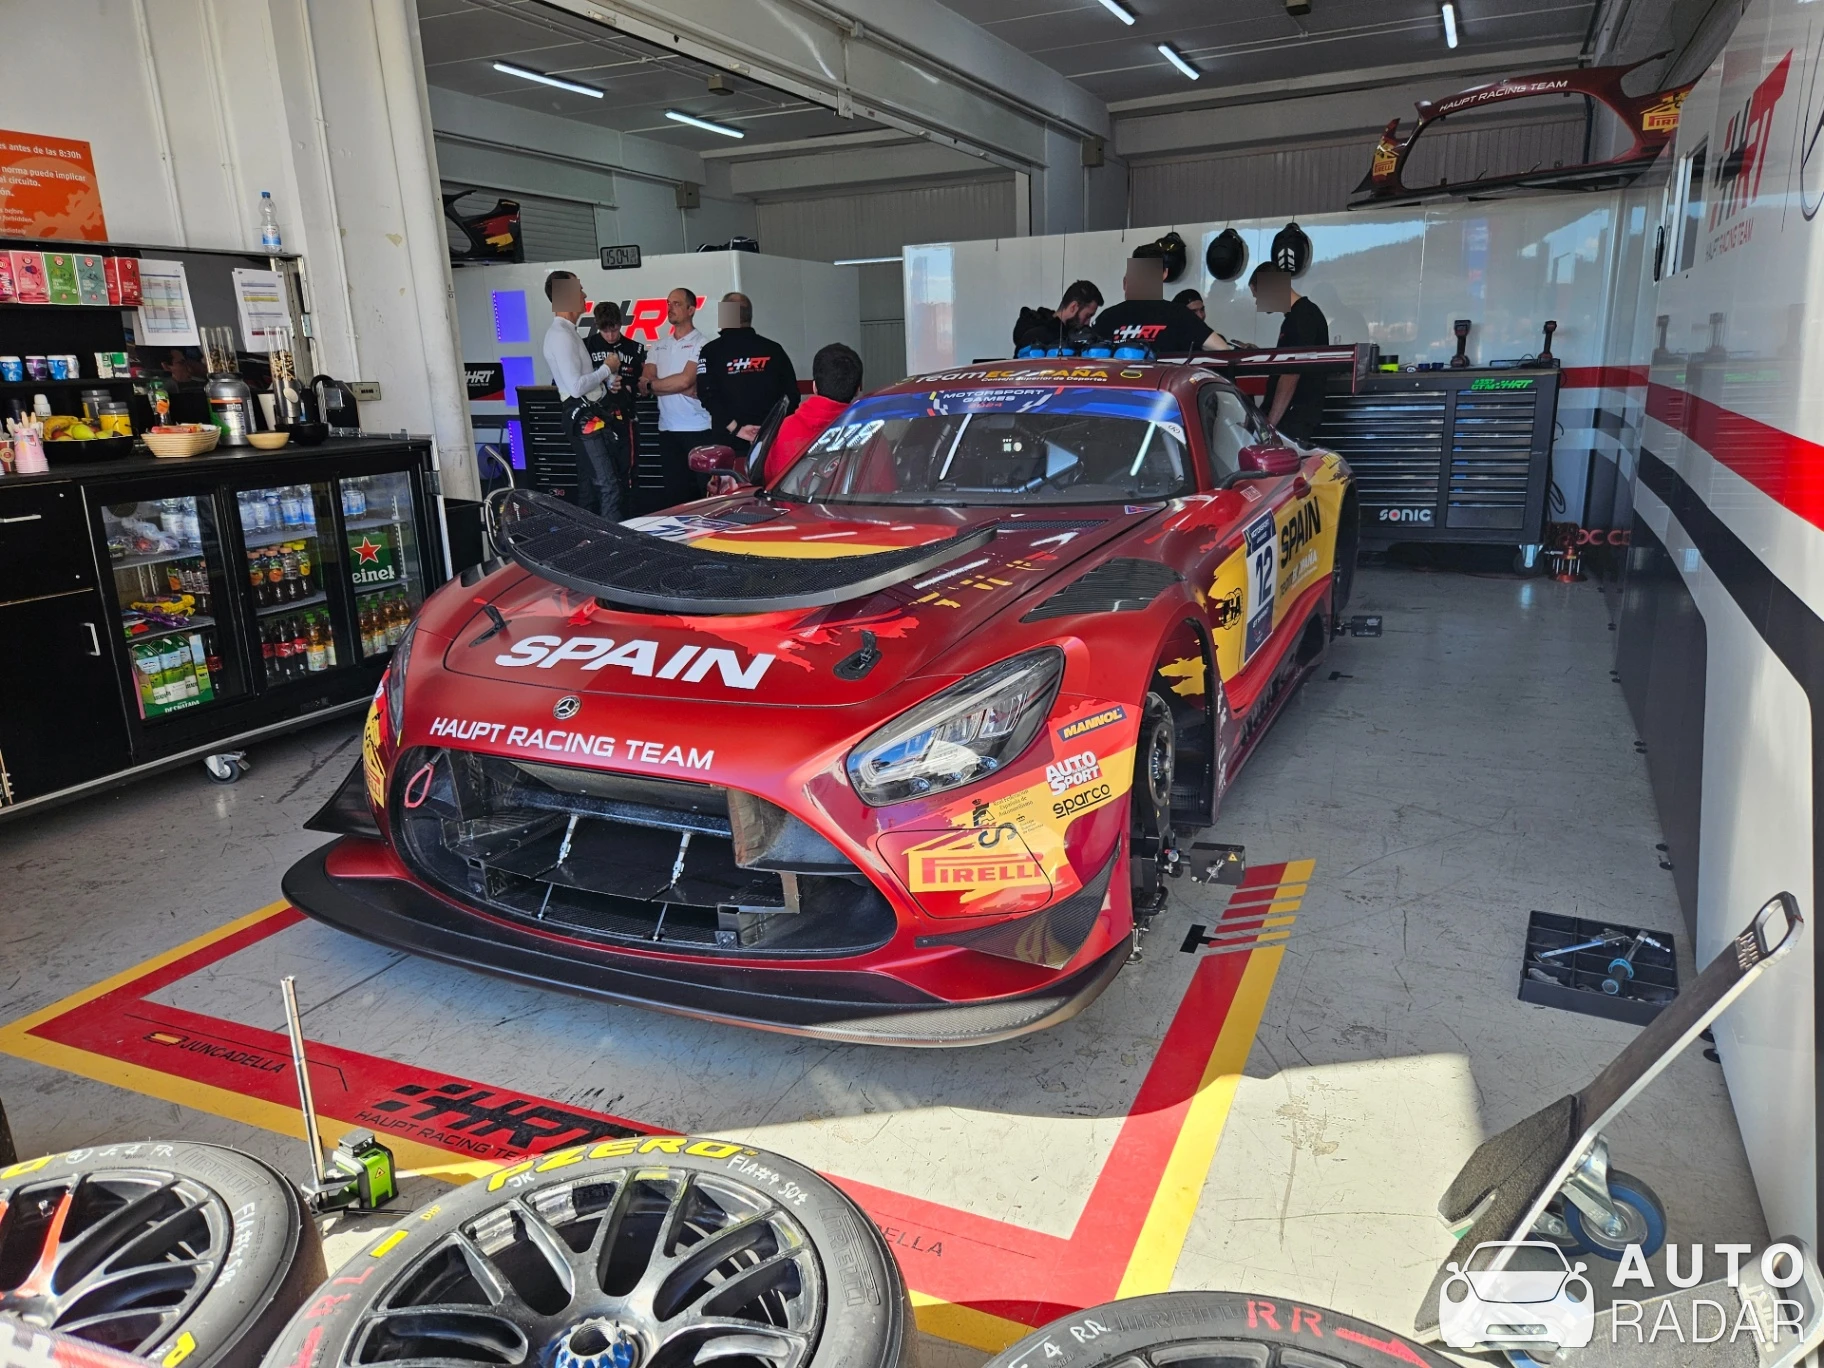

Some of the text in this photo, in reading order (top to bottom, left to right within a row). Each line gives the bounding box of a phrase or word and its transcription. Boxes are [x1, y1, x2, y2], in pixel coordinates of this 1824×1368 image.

[1439, 80, 1568, 112] HAUPT RACING TEAM
[9, 144, 31, 153] antes
[33, 146, 44, 154] de
[45, 148, 57, 156] las
[59, 149, 81, 159] 8:30h
[2, 166, 86, 182] norma puede implicar
[1120, 325, 1168, 339] HRT
[734, 356, 771, 370] HRT
[943, 389, 1045, 399] MOTORSPORT
[1280, 496, 1322, 569] SPAIN
[1255, 545, 1273, 607] 12
[495, 635, 776, 690] SPAIN
[1064, 710, 1122, 739] MANNOL
[430, 717, 715, 770] HAUPT RACING TEAM
[1045, 751, 1097, 783] AUTO
[1049, 765, 1100, 797] SPORT
[1052, 784, 1111, 815] sparco
[922, 852, 1044, 884] PIRELLI
[180, 1040, 287, 1074] JUNCADELLA
[354, 1111, 420, 1133] HAUPT
[417, 1126, 496, 1155] RACING
